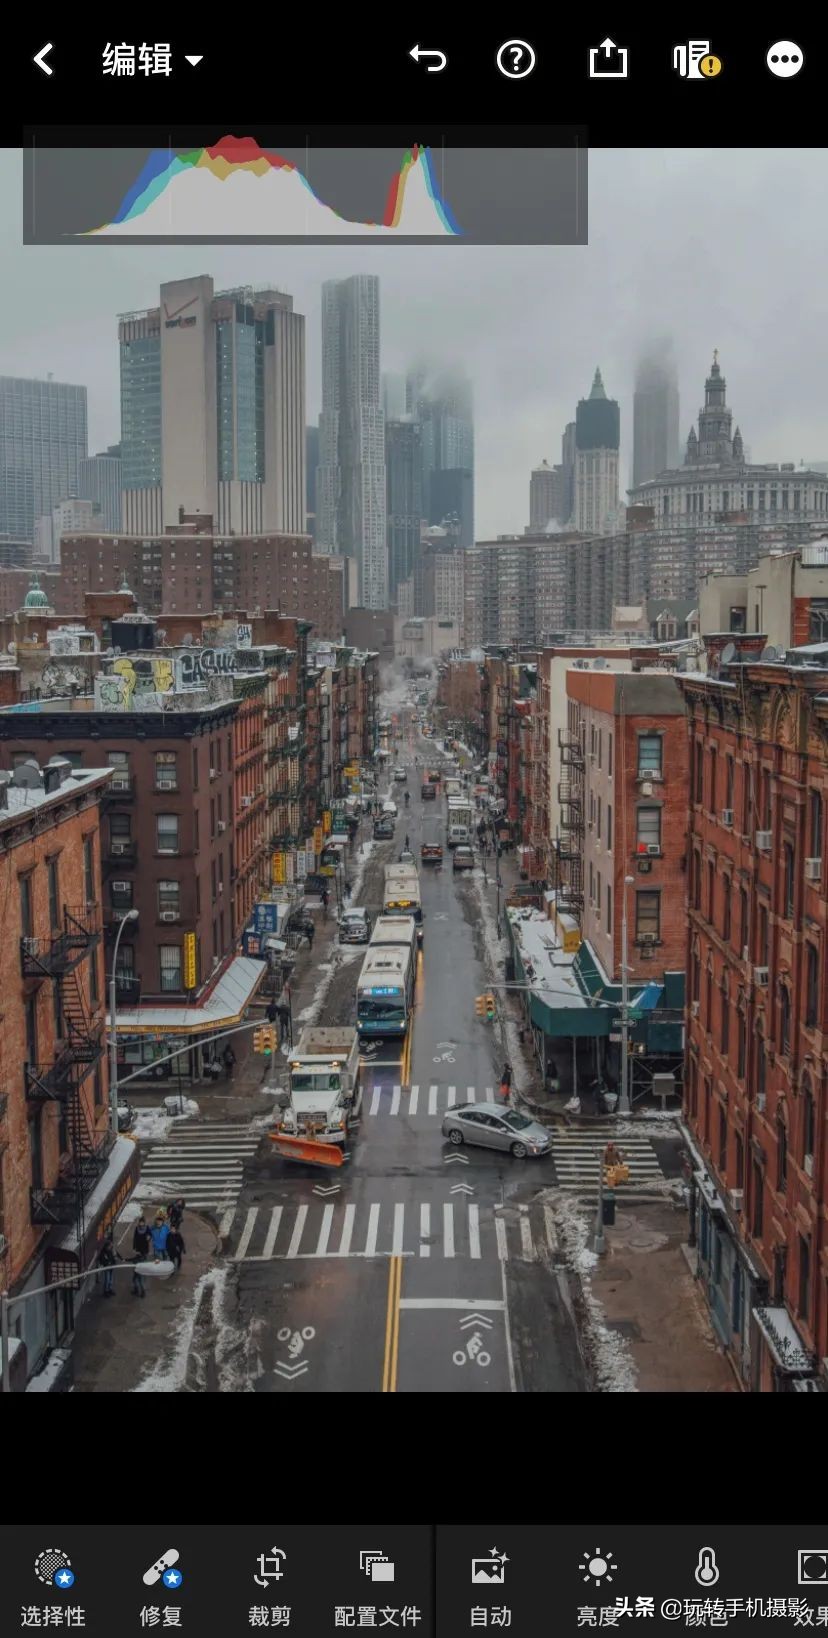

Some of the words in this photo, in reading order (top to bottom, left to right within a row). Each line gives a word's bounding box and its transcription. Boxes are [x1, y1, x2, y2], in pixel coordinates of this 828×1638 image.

[102, 42, 172, 76] 编辑
[20, 1605, 86, 1627] 选择性
[139, 1605, 183, 1627] 修复
[248, 1605, 292, 1627] 裁剪
[334, 1605, 422, 1627] 配置文件
[470, 1605, 512, 1627] 自动
[576, 1605, 620, 1627] 亮度
